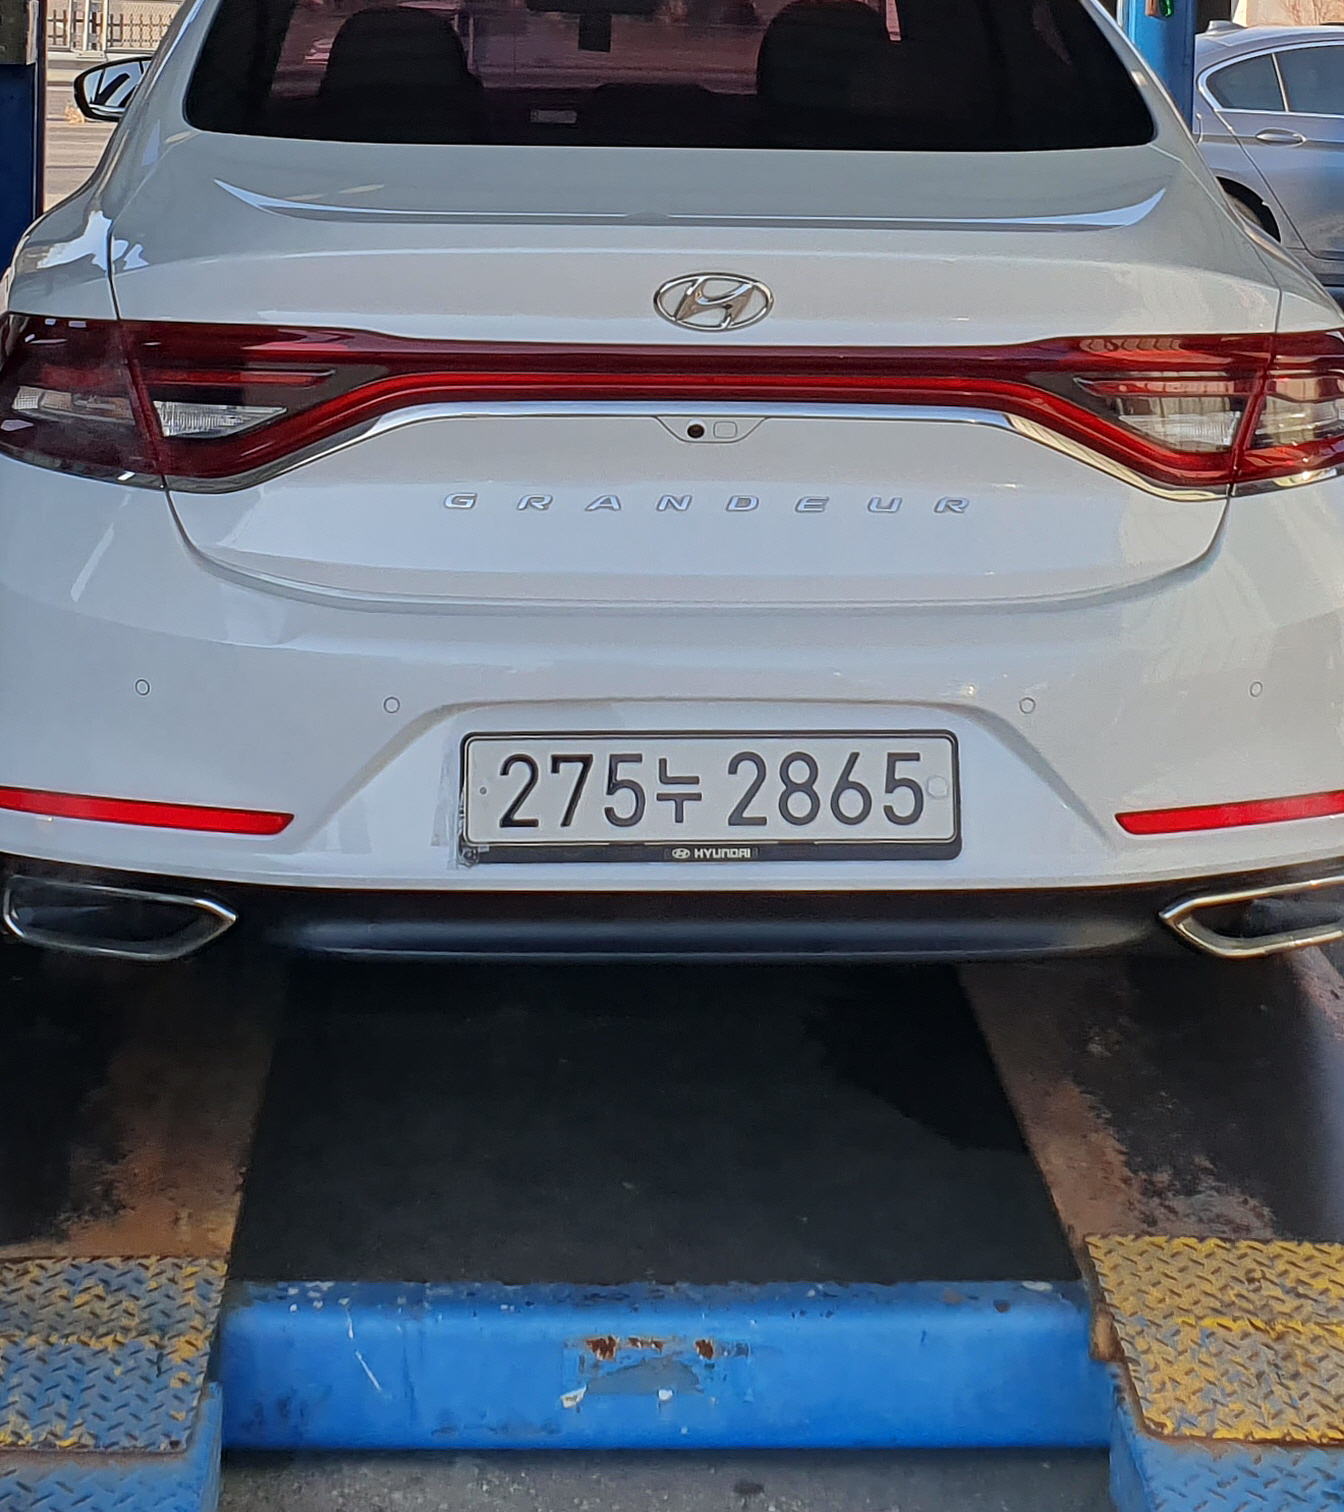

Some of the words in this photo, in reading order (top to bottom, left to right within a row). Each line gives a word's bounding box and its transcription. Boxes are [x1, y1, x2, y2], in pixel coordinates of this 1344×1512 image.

[442, 492, 970, 514] GRANDEUR
[498, 752, 703, 829] 275누
[726, 750, 925, 828] 2865
[694, 847, 752, 859] HYUNDAI
